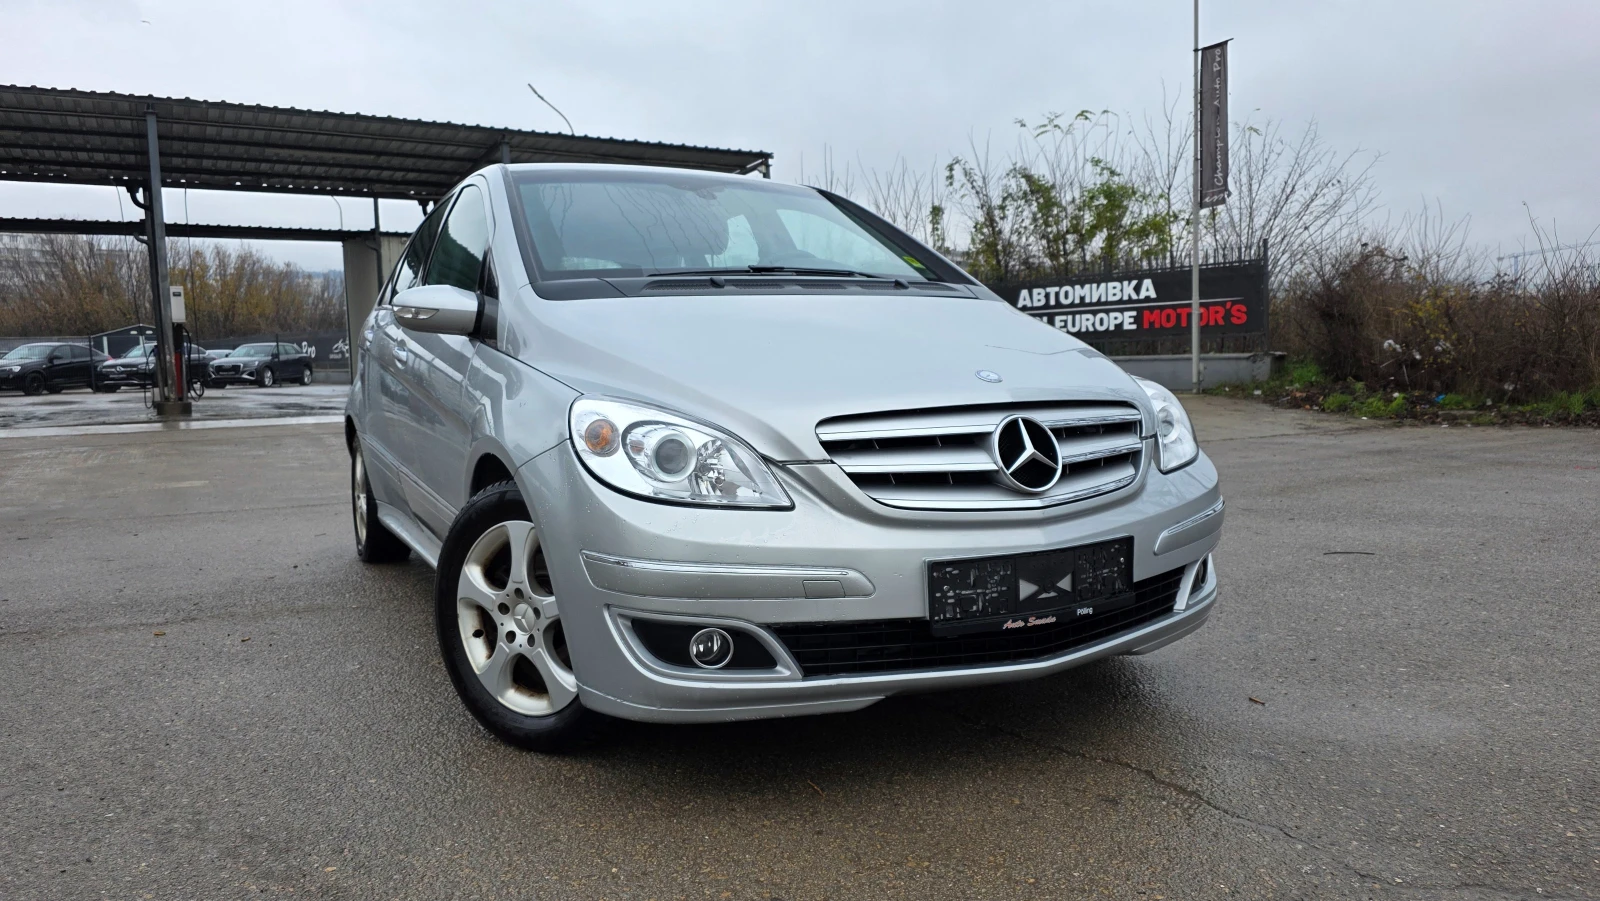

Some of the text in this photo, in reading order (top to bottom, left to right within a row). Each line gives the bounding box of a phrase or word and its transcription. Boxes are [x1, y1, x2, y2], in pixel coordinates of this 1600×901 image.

[1213, 48, 1221, 72] Pro
[1017, 278, 1157, 308] АВТОМИВКА
[1054, 301, 1248, 333] EUROPE MOTOR'S
